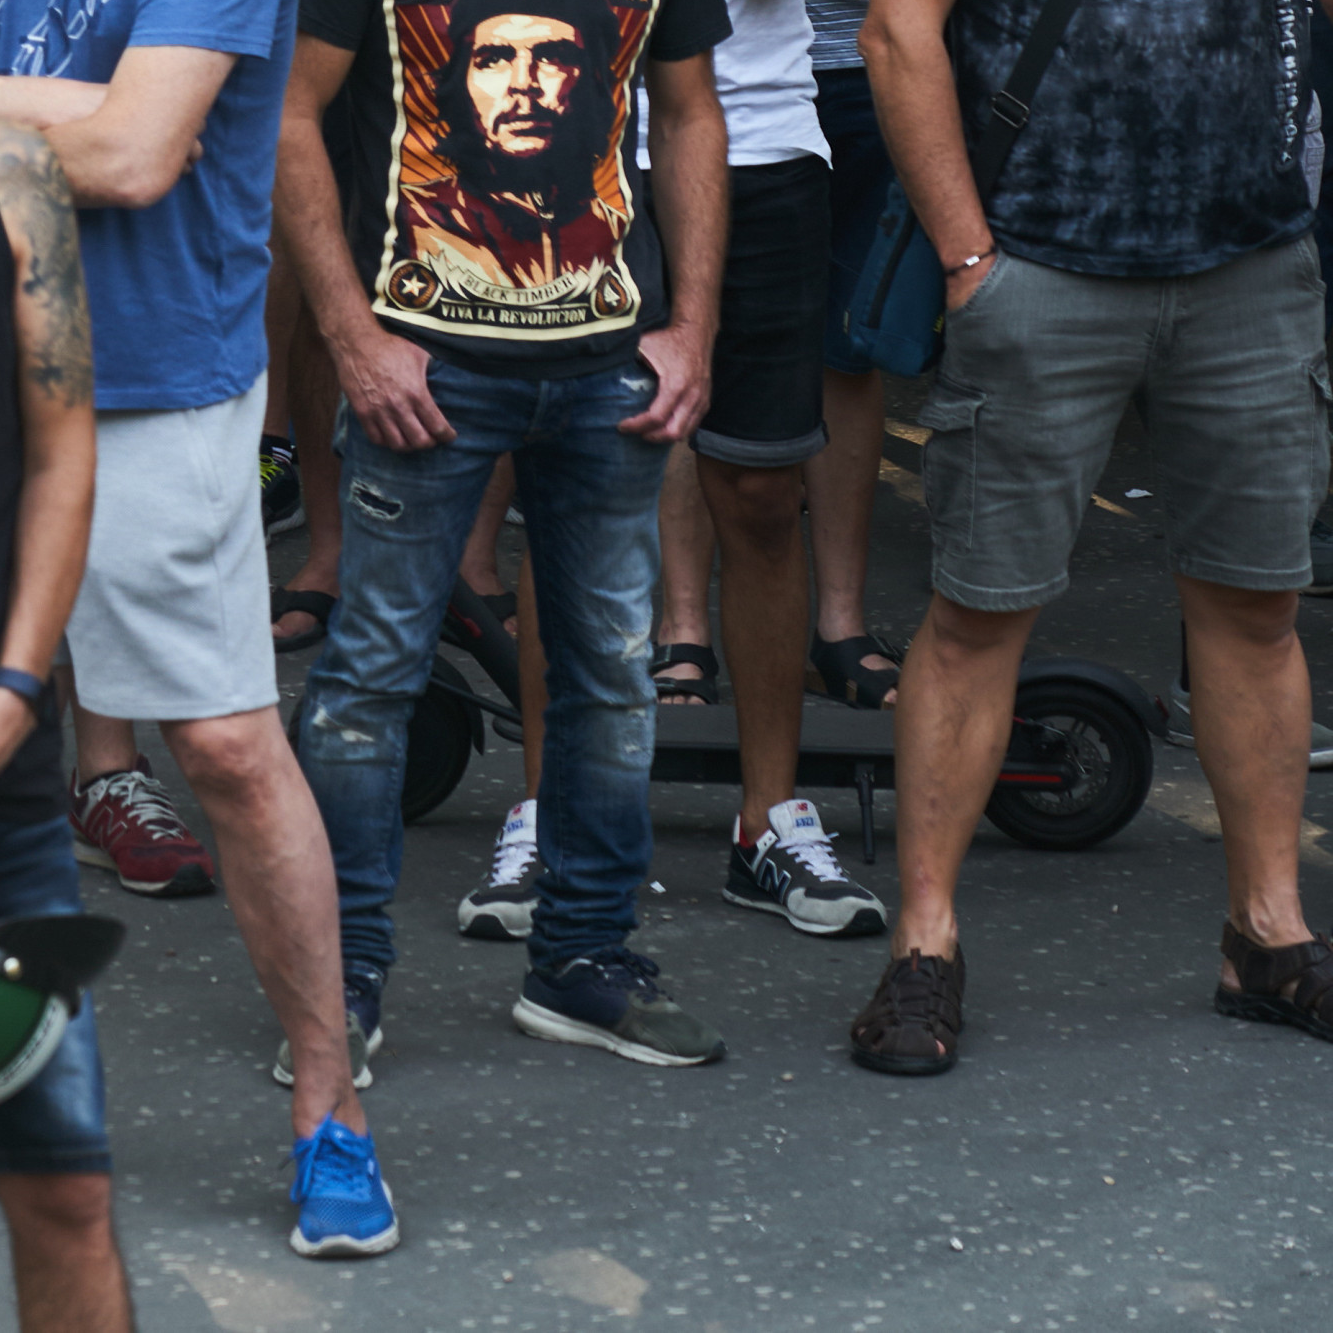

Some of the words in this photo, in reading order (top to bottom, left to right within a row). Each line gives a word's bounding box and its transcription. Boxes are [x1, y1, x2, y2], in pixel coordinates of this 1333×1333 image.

[463, 275, 509, 302] BLACK
[516, 275, 574, 304] TIMBER
[441, 303, 474, 320] VIVA
[477, 307, 496, 322] LA
